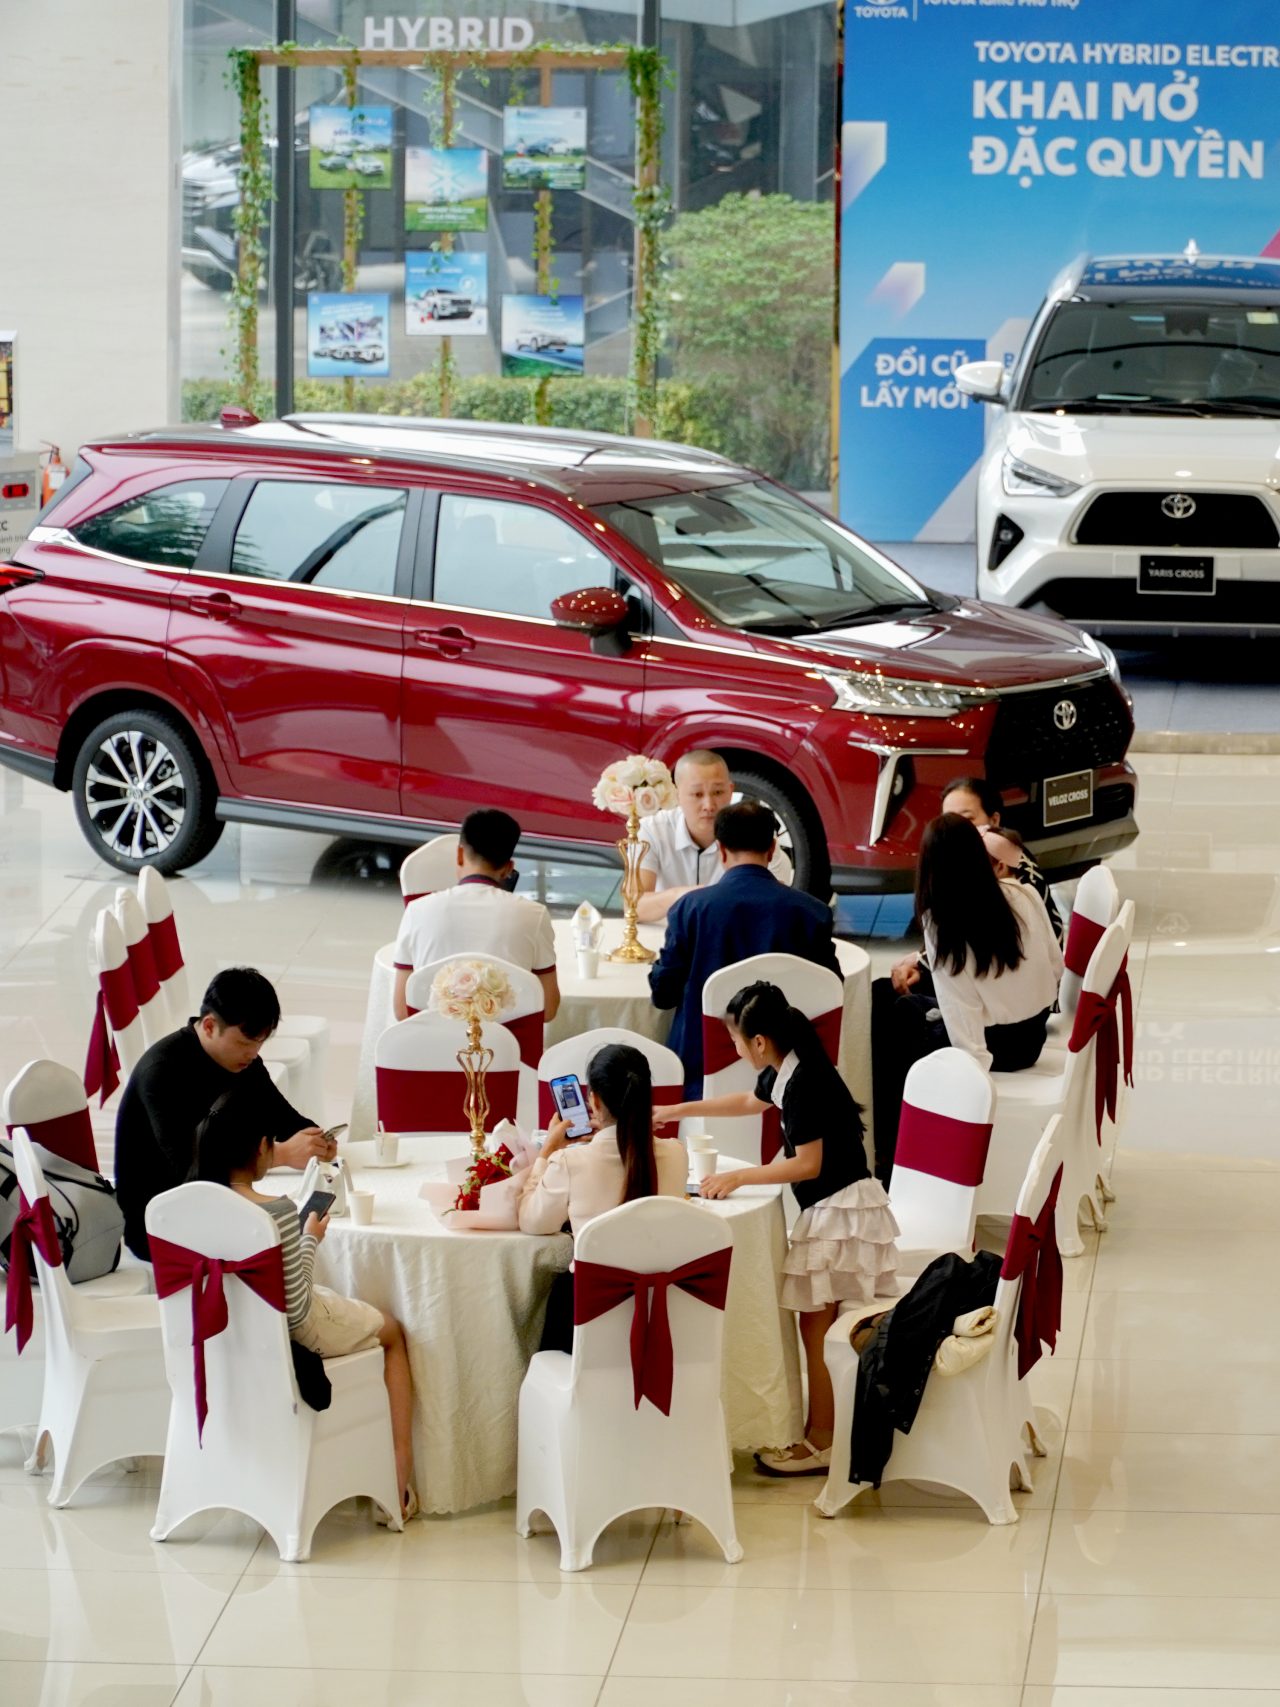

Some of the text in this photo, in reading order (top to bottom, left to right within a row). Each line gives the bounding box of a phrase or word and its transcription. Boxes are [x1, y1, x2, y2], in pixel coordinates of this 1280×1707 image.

[854, 6, 908, 18] TOYOTA
[364, 17, 534, 50] HYBRID
[974, 41, 1077, 63] TOYOTA
[1083, 43, 1180, 65] HYBRID
[973, 70, 1200, 122] KHAI MỞ
[969, 126, 1264, 188] ĐẶC QUYỀN
[875, 346, 926, 377] ĐỔI
[860, 379, 909, 408] LẤY
[1148, 568, 1205, 579] YARIS CROSS
[1048, 789, 1089, 807] VELOZ CROSS
